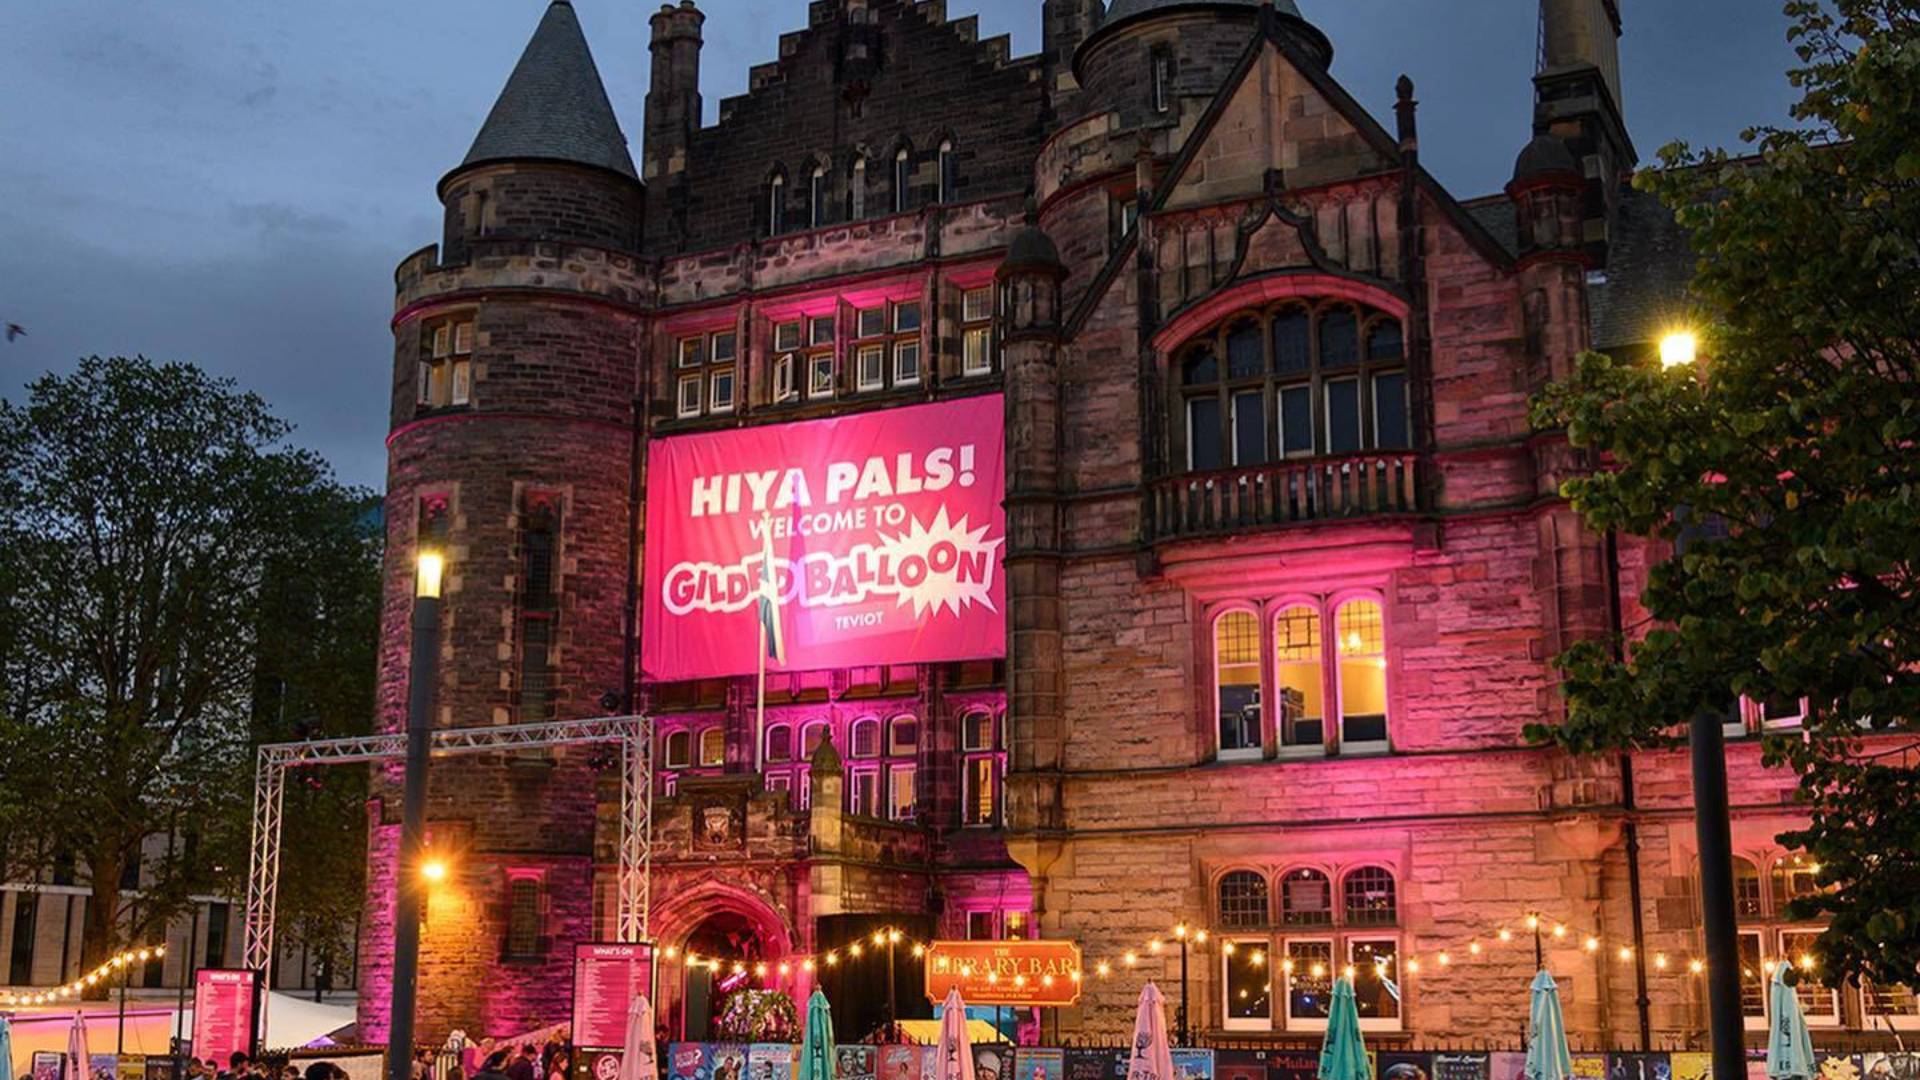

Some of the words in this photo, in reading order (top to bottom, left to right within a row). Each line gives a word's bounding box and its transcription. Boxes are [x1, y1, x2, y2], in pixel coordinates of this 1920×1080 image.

[690, 467, 811, 518] HIYA
[826, 443, 977, 502] PALS!
[748, 507, 866, 541] WELCOME
[873, 503, 906, 527] TO
[803, 540, 989, 600] BALLOON
[835, 610, 884, 631] TEVIOT
[931, 957, 1024, 975] LIBRARY
[1029, 957, 1073, 975] BAR
